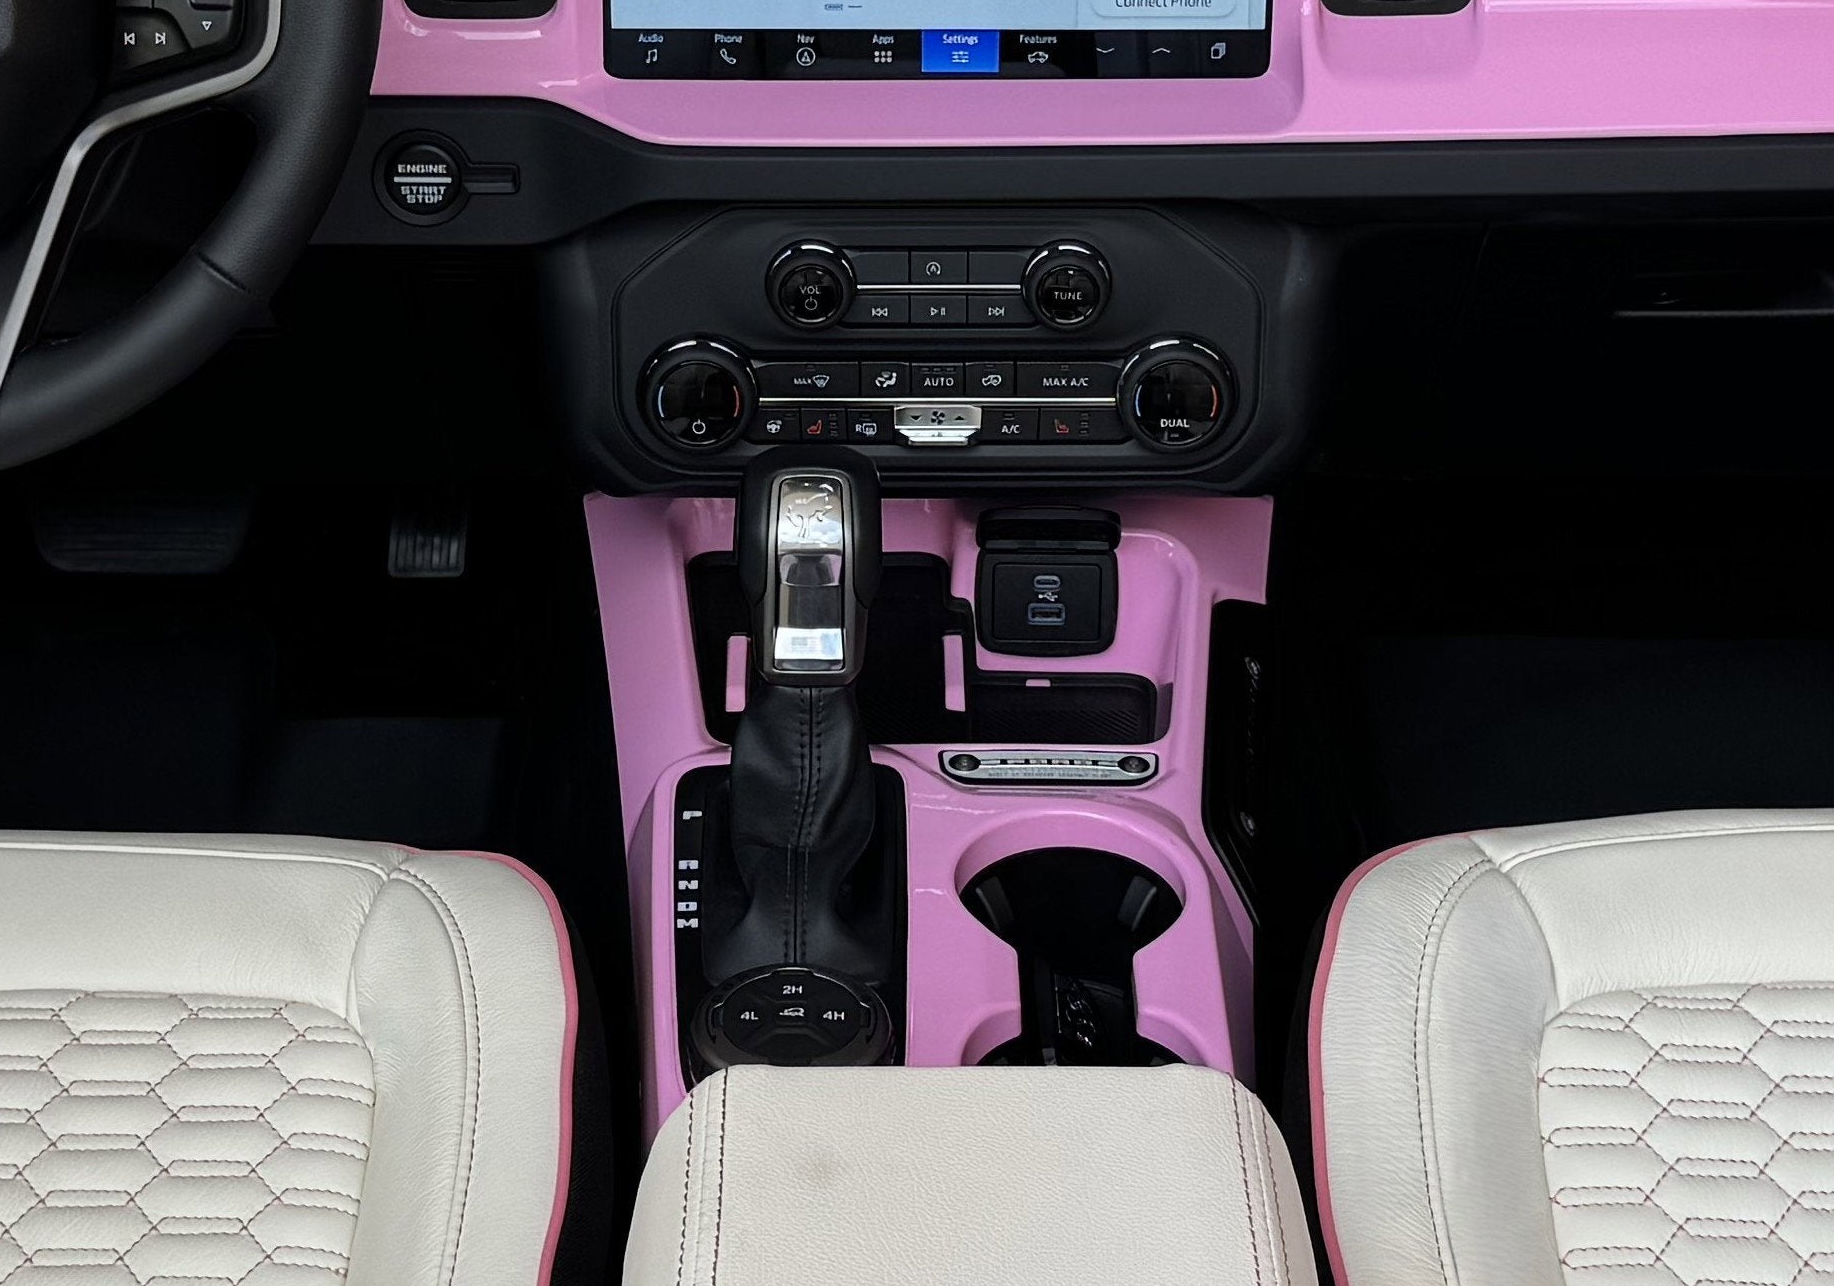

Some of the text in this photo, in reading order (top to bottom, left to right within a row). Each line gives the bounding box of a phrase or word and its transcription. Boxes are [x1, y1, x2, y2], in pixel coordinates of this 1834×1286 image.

[638, 34, 664, 44] Audio
[714, 34, 743, 44] Phone
[797, 34, 815, 44] Nav
[872, 34, 895, 46] Apps
[942, 34, 979, 46] Settings
[1019, 34, 1058, 45] Features
[397, 164, 447, 174] ENGINE
[401, 185, 446, 195] START
[406, 194, 443, 204] STOP
[799, 285, 821, 295] VOL
[1054, 291, 1083, 300] TUNE
[924, 377, 954, 387] AUTO
[1042, 377, 1089, 387] MAX A/C
[1160, 418, 1190, 428] DUAL
[1001, 425, 1020, 434] A/C
[678, 880, 699, 890] N
[676, 918, 699, 928] M
[782, 985, 803, 994] 2H
[740, 1011, 845, 1021] 4L 4H
